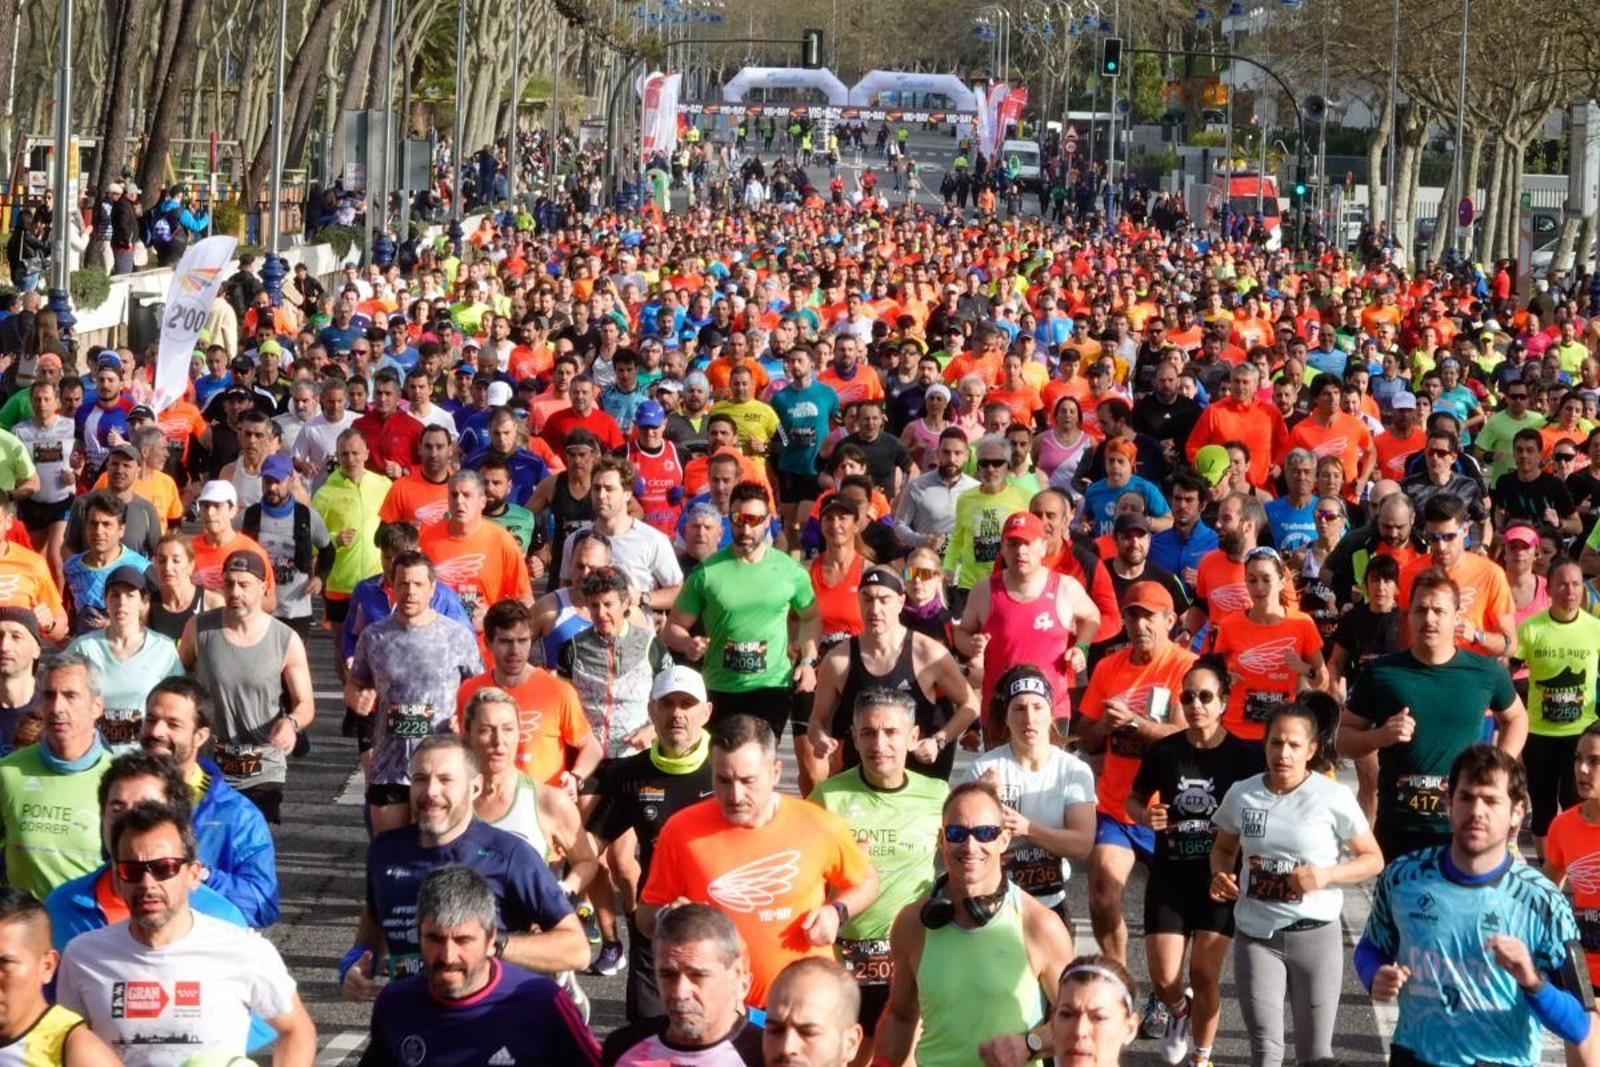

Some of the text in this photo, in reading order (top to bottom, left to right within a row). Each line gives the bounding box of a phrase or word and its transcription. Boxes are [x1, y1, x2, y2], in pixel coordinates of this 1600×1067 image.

[394, 720, 428, 735] 2228
[1408, 795, 1440, 811] 417
[21, 803, 73, 823] PONTE
[20, 821, 70, 836] CORRER
[1244, 822, 1262, 834] BOX
[1015, 868, 1057, 886] 2736
[128, 985, 161, 1000] GRAN
